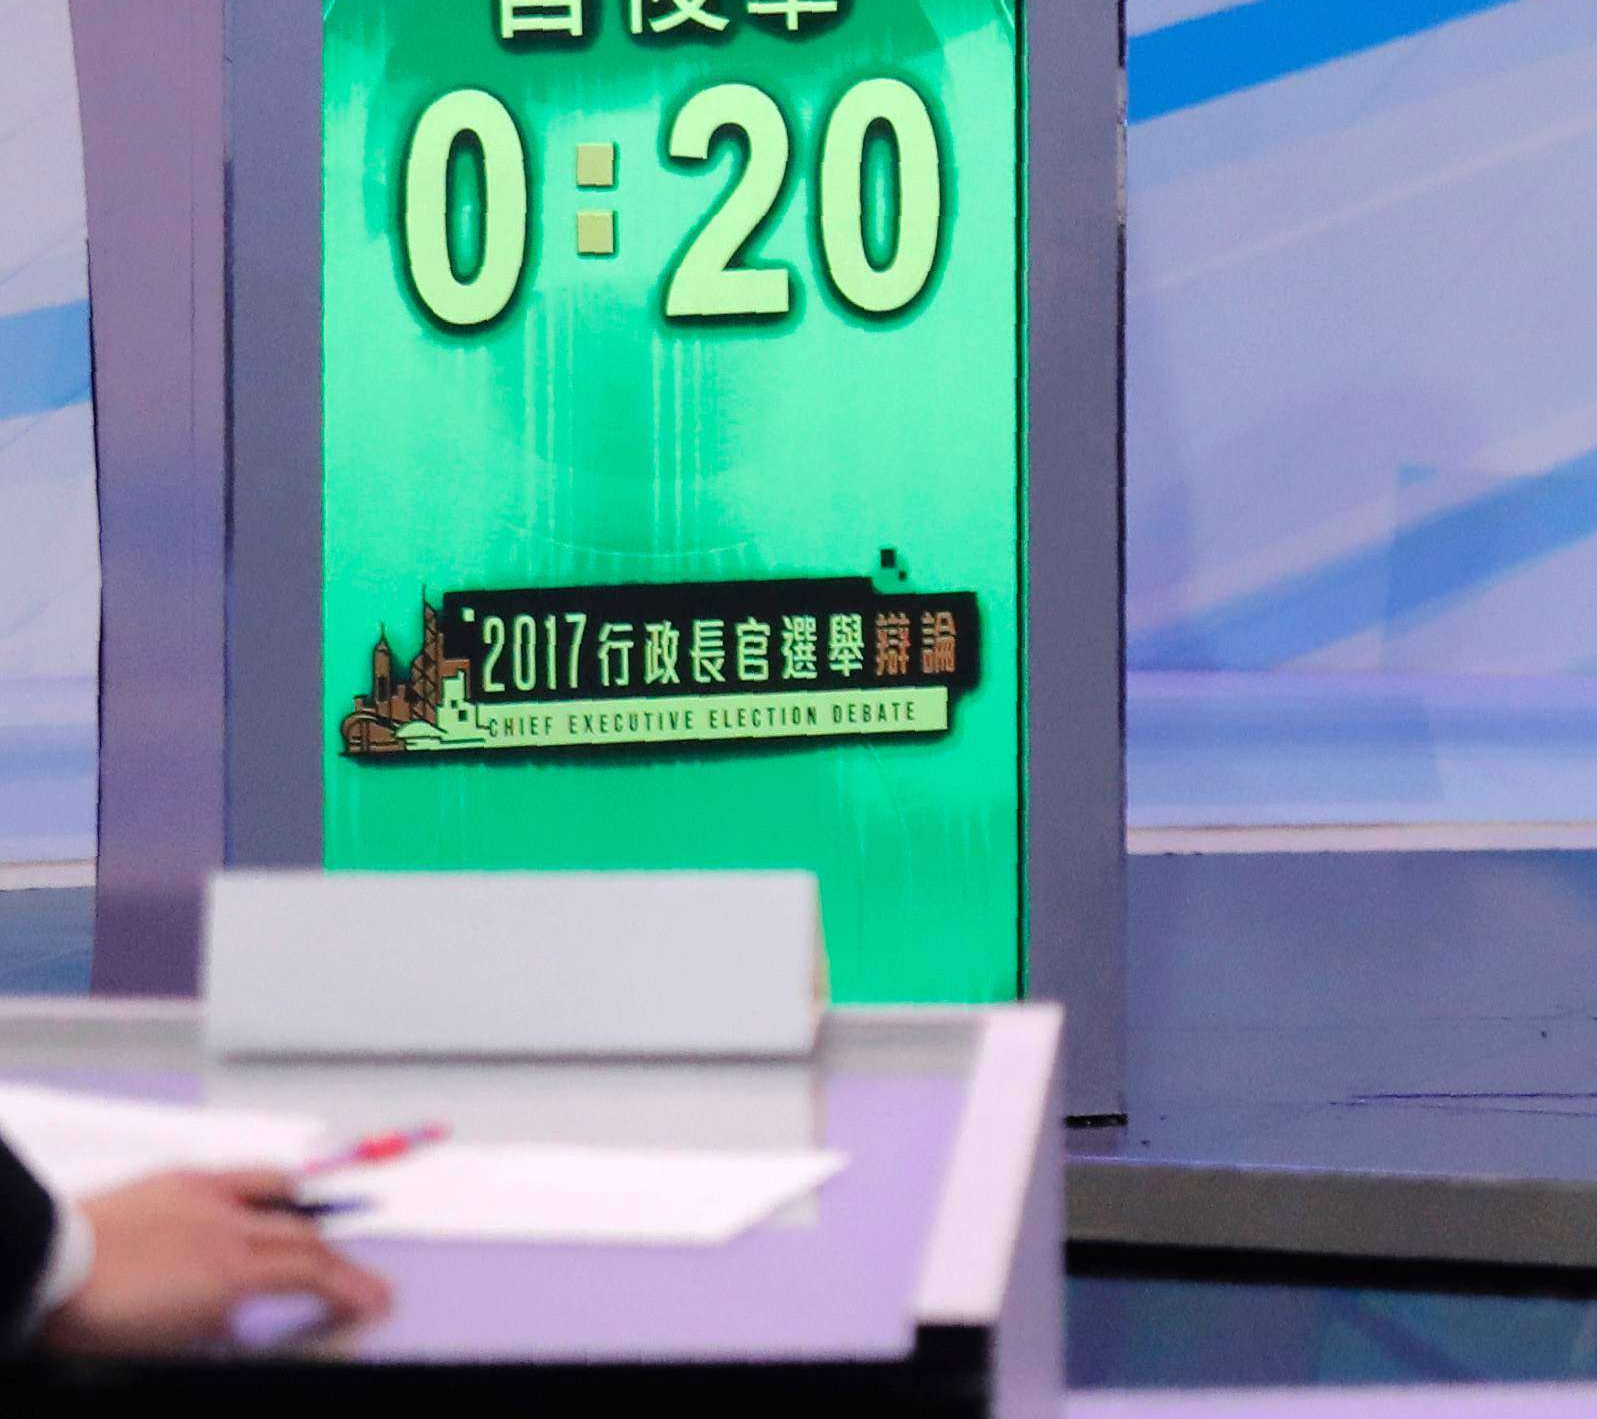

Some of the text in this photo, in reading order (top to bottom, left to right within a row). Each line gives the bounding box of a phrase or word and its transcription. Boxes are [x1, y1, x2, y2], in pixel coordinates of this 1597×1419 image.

[406, 79, 943, 325] 0:20
[481, 611, 957, 693] 2017行政長官選舉辯論
[489, 701, 917, 737] CHIEF EXECUTIVE ELECTION DEBATE
